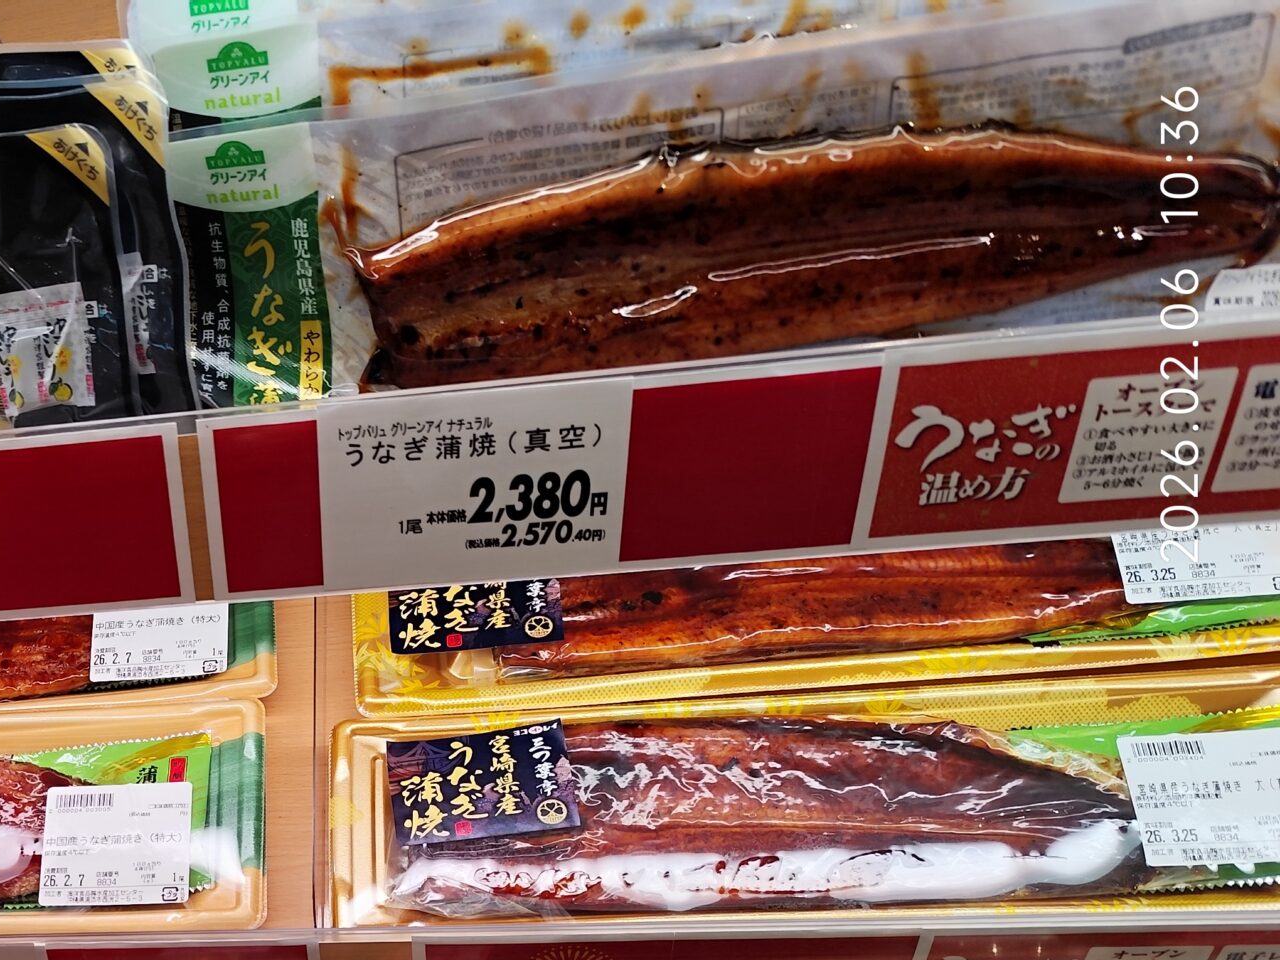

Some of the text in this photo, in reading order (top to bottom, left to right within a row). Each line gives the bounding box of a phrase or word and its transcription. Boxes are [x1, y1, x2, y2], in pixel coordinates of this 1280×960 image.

[209, 71, 270, 89] グリーンアイ
[210, 55, 265, 71] TOPVALU
[204, 87, 281, 111] natural
[53, 138, 100, 181] あけぐち
[209, 169, 267, 185] グリーンアイ
[206, 184, 280, 204] natural
[290, 217, 319, 316] 鹿児島県産
[303, 330, 320, 396] やわらか
[391, 420, 443, 436] グリーンアイ
[447, 416, 493, 432] ナチュラル
[894, 403, 1077, 472] うなぎの
[919, 465, 1033, 506] 温め方
[398, 519, 423, 535] 1尾
[398, 589, 443, 650] 蒲焼
[448, 740, 490, 820] うなぎ
[488, 735, 524, 817] 宮崎県産
[400, 771, 452, 840] 蒲焼
